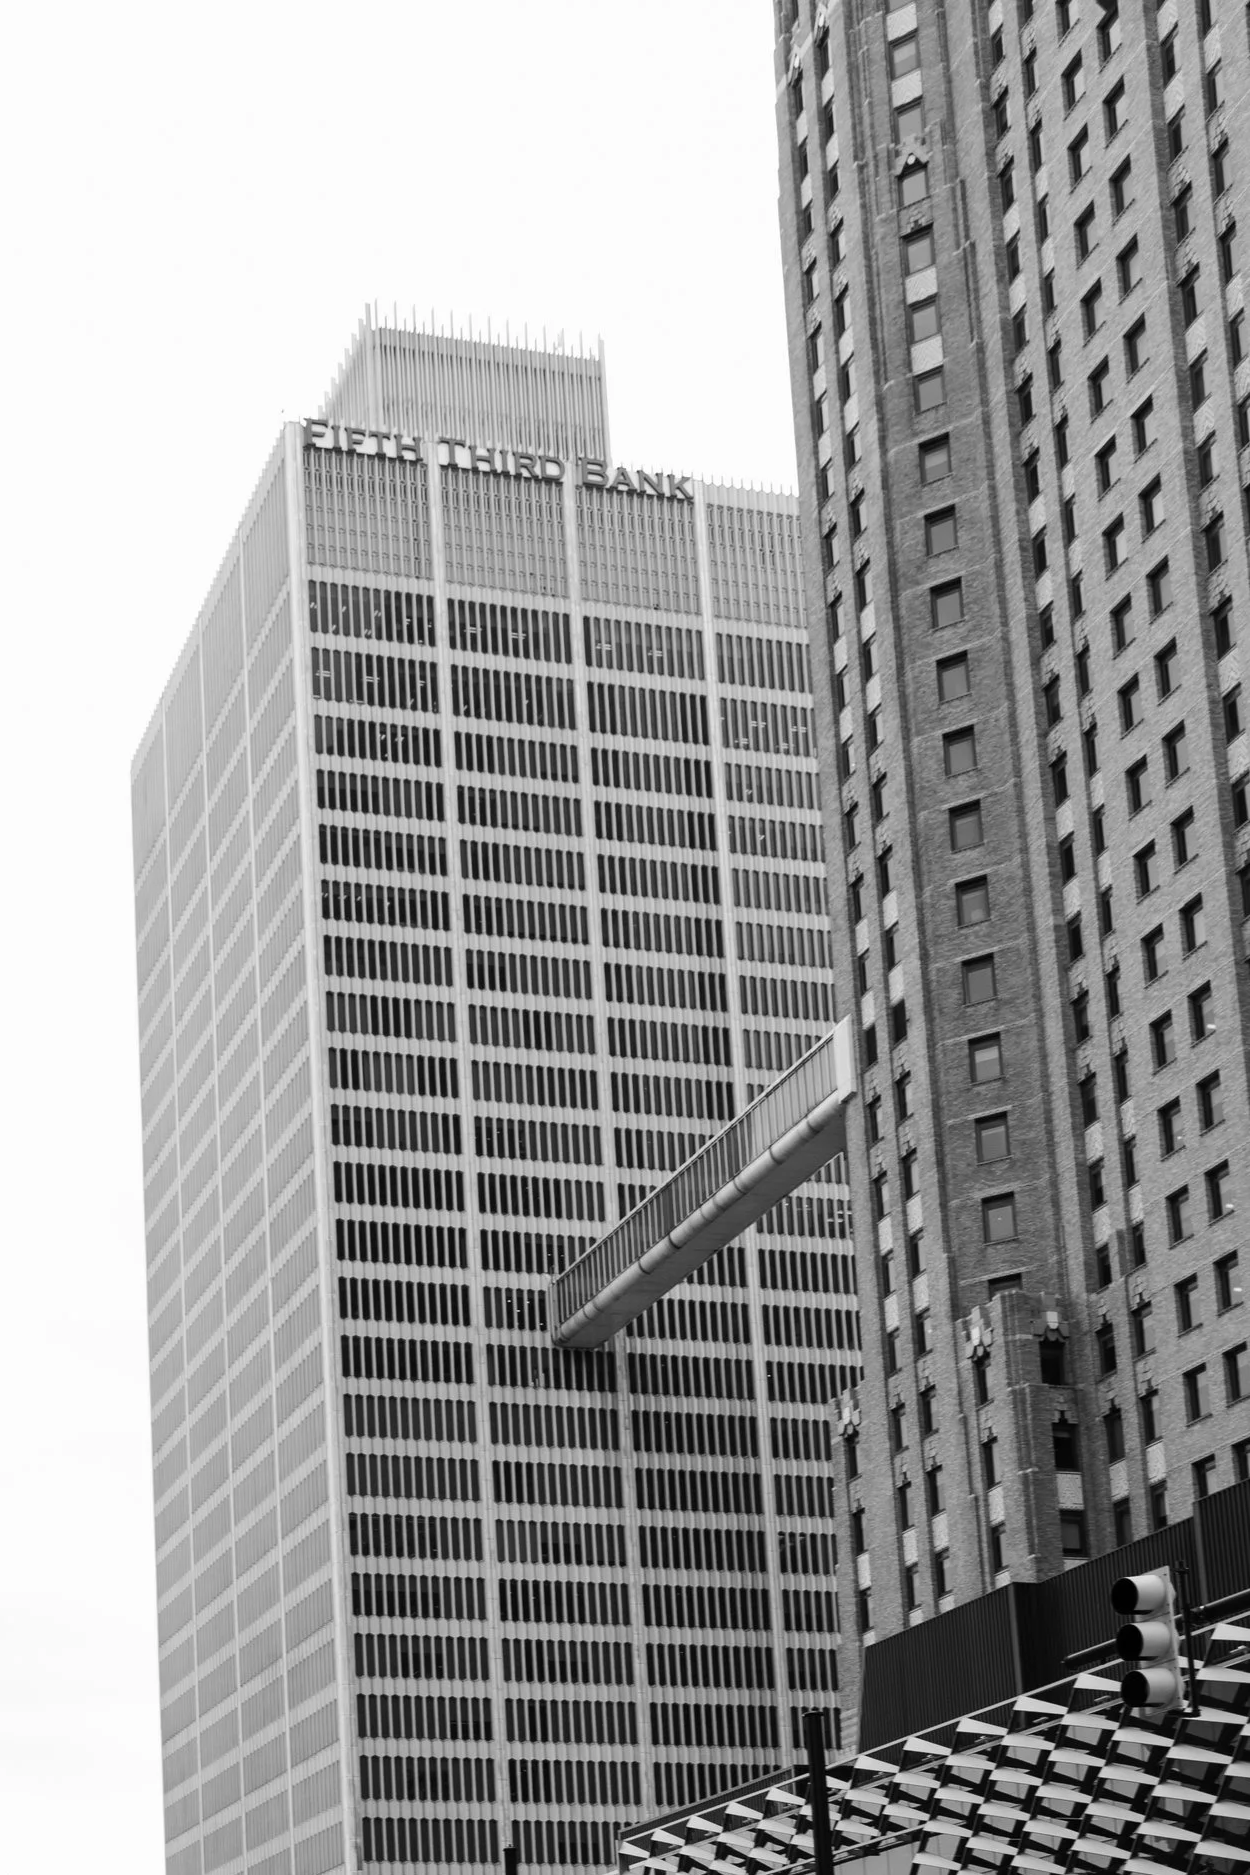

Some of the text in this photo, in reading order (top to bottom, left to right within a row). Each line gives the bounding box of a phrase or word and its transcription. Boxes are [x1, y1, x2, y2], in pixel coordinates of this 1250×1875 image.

[303, 417, 695, 501] FIFTH THIRD BANK
